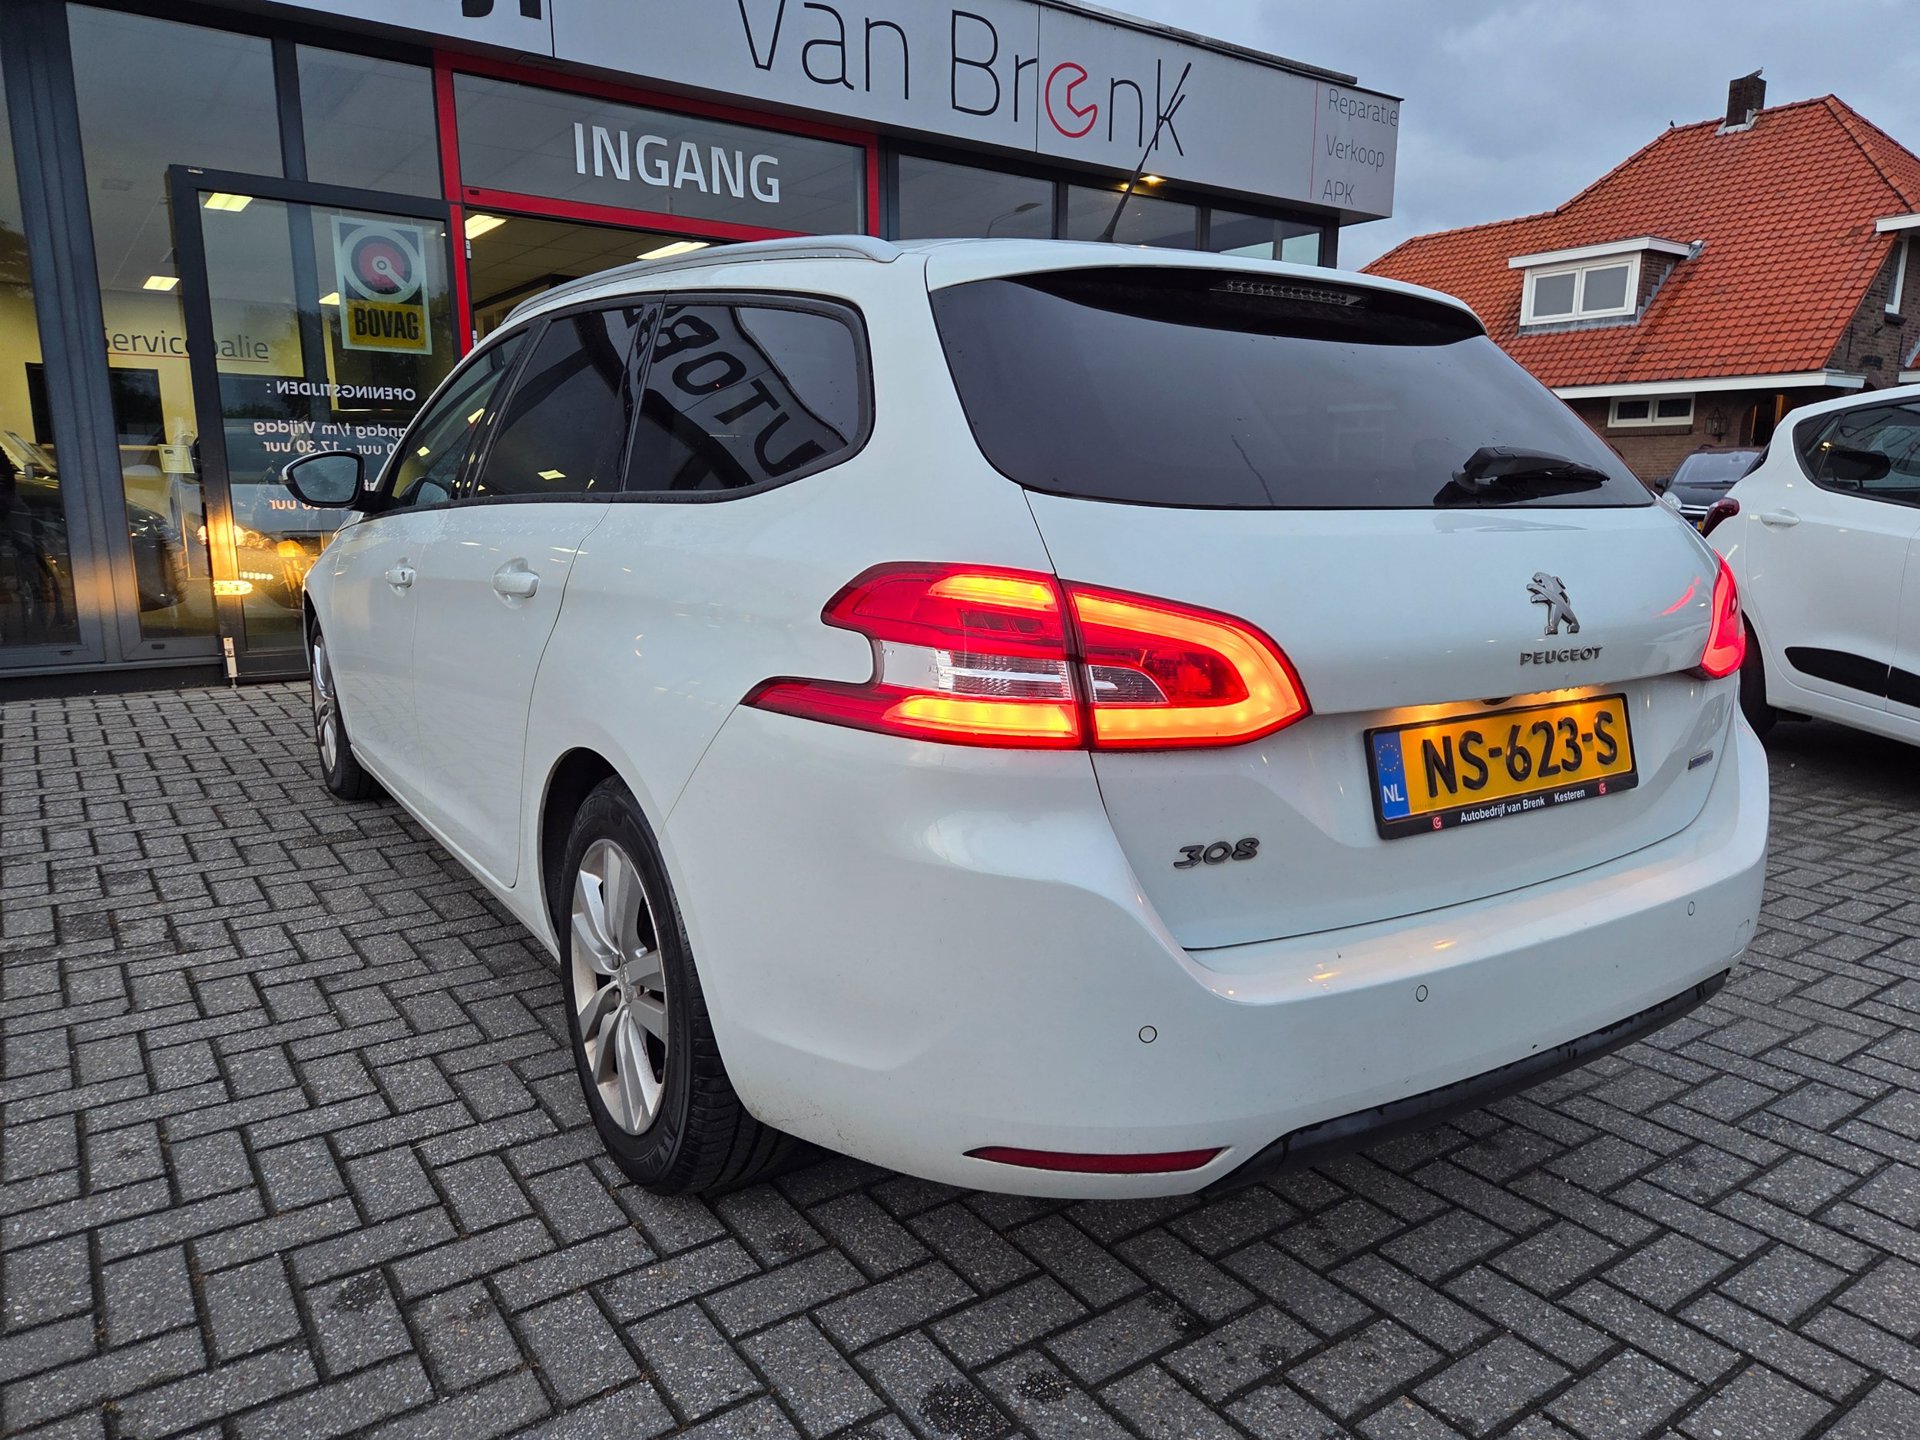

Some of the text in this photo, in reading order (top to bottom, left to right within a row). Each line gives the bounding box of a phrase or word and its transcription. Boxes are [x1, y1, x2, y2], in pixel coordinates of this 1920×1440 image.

[738, 0, 909, 100] Van
[1328, 88, 1398, 127] Reparatie
[573, 122, 780, 204] INGANG
[1325, 133, 1385, 173] Verkoop
[1321, 179, 1355, 205] APK
[353, 307, 420, 341] BOVAG
[1519, 645, 1603, 666] PEUGEOT
[1421, 710, 1618, 799] NS-623-S
[1383, 783, 1405, 804] NL
[1460, 788, 1586, 823] Autobedrijf van Brenk Kesteren
[1173, 837, 1260, 870] 308
